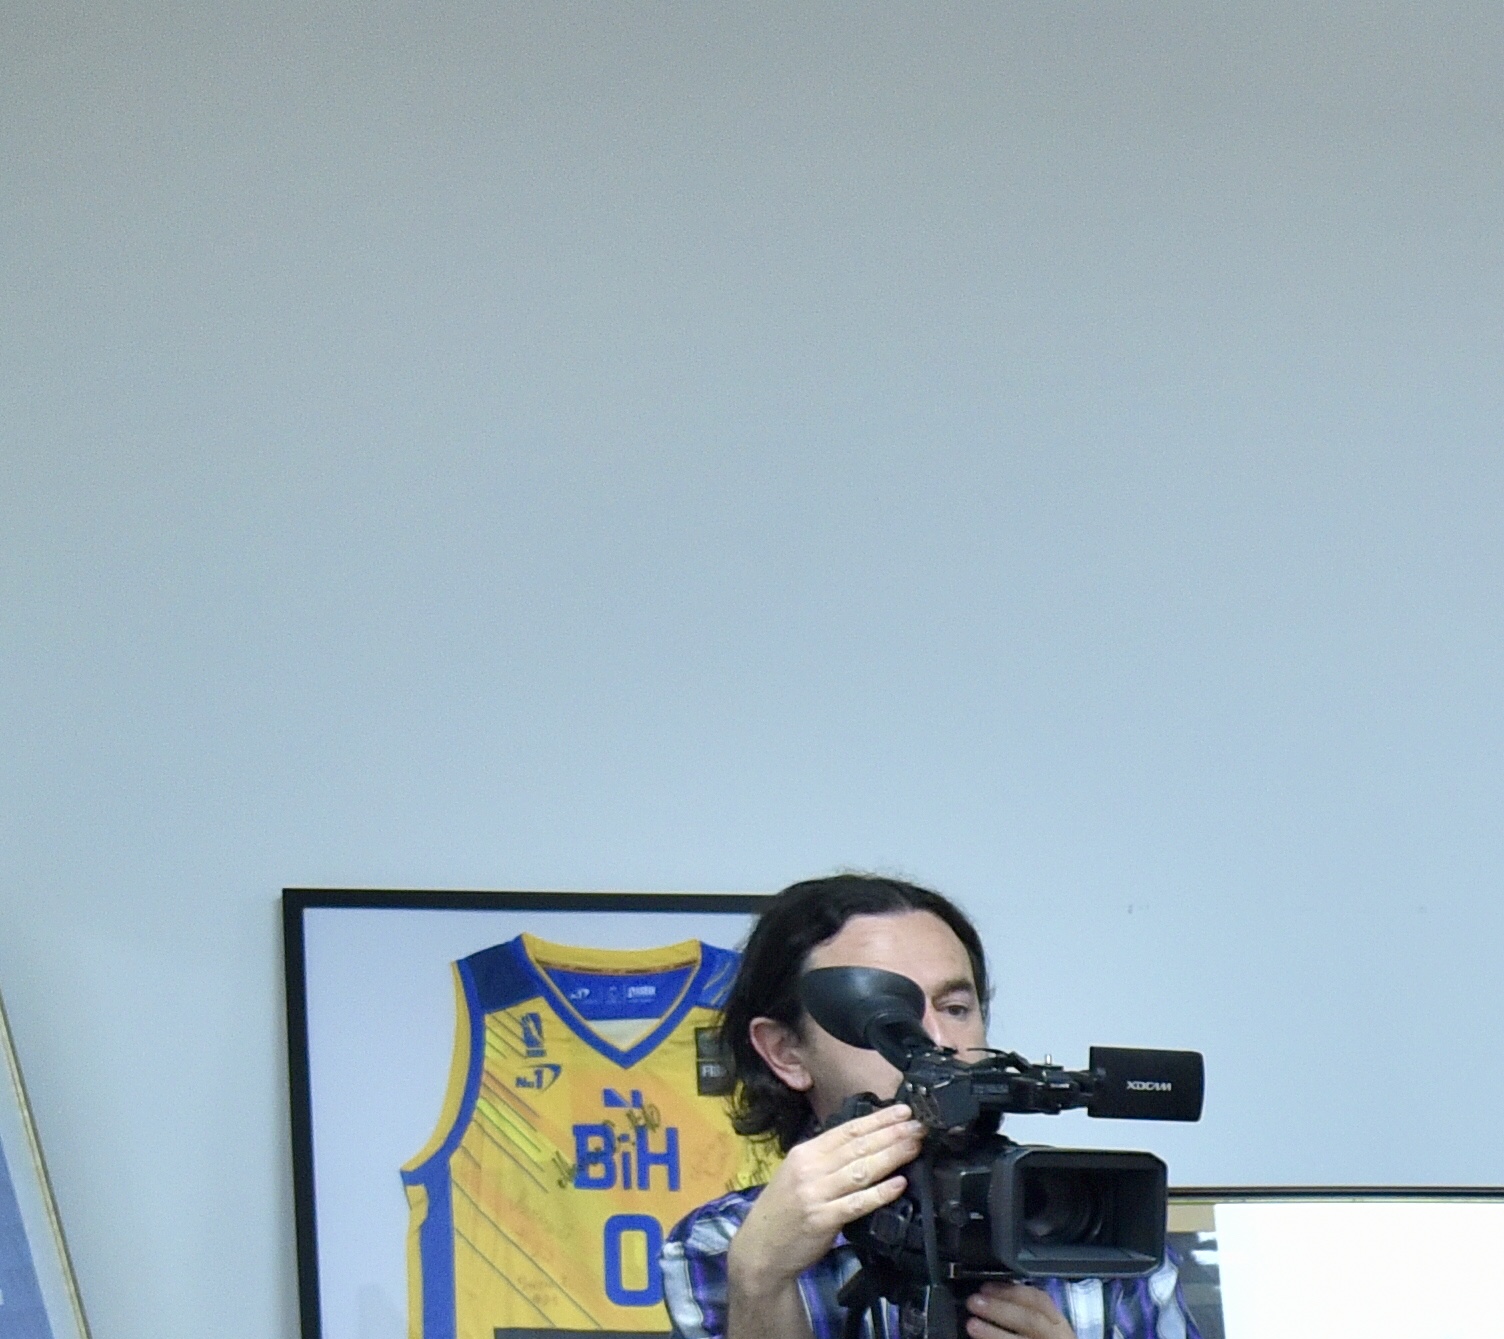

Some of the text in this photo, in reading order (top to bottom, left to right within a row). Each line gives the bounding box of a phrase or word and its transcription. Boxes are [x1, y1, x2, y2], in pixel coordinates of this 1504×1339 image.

[1127, 1081, 1172, 1091] XDCAM
[572, 1124, 680, 1192] BiH
[603, 1213, 663, 1307] 0
